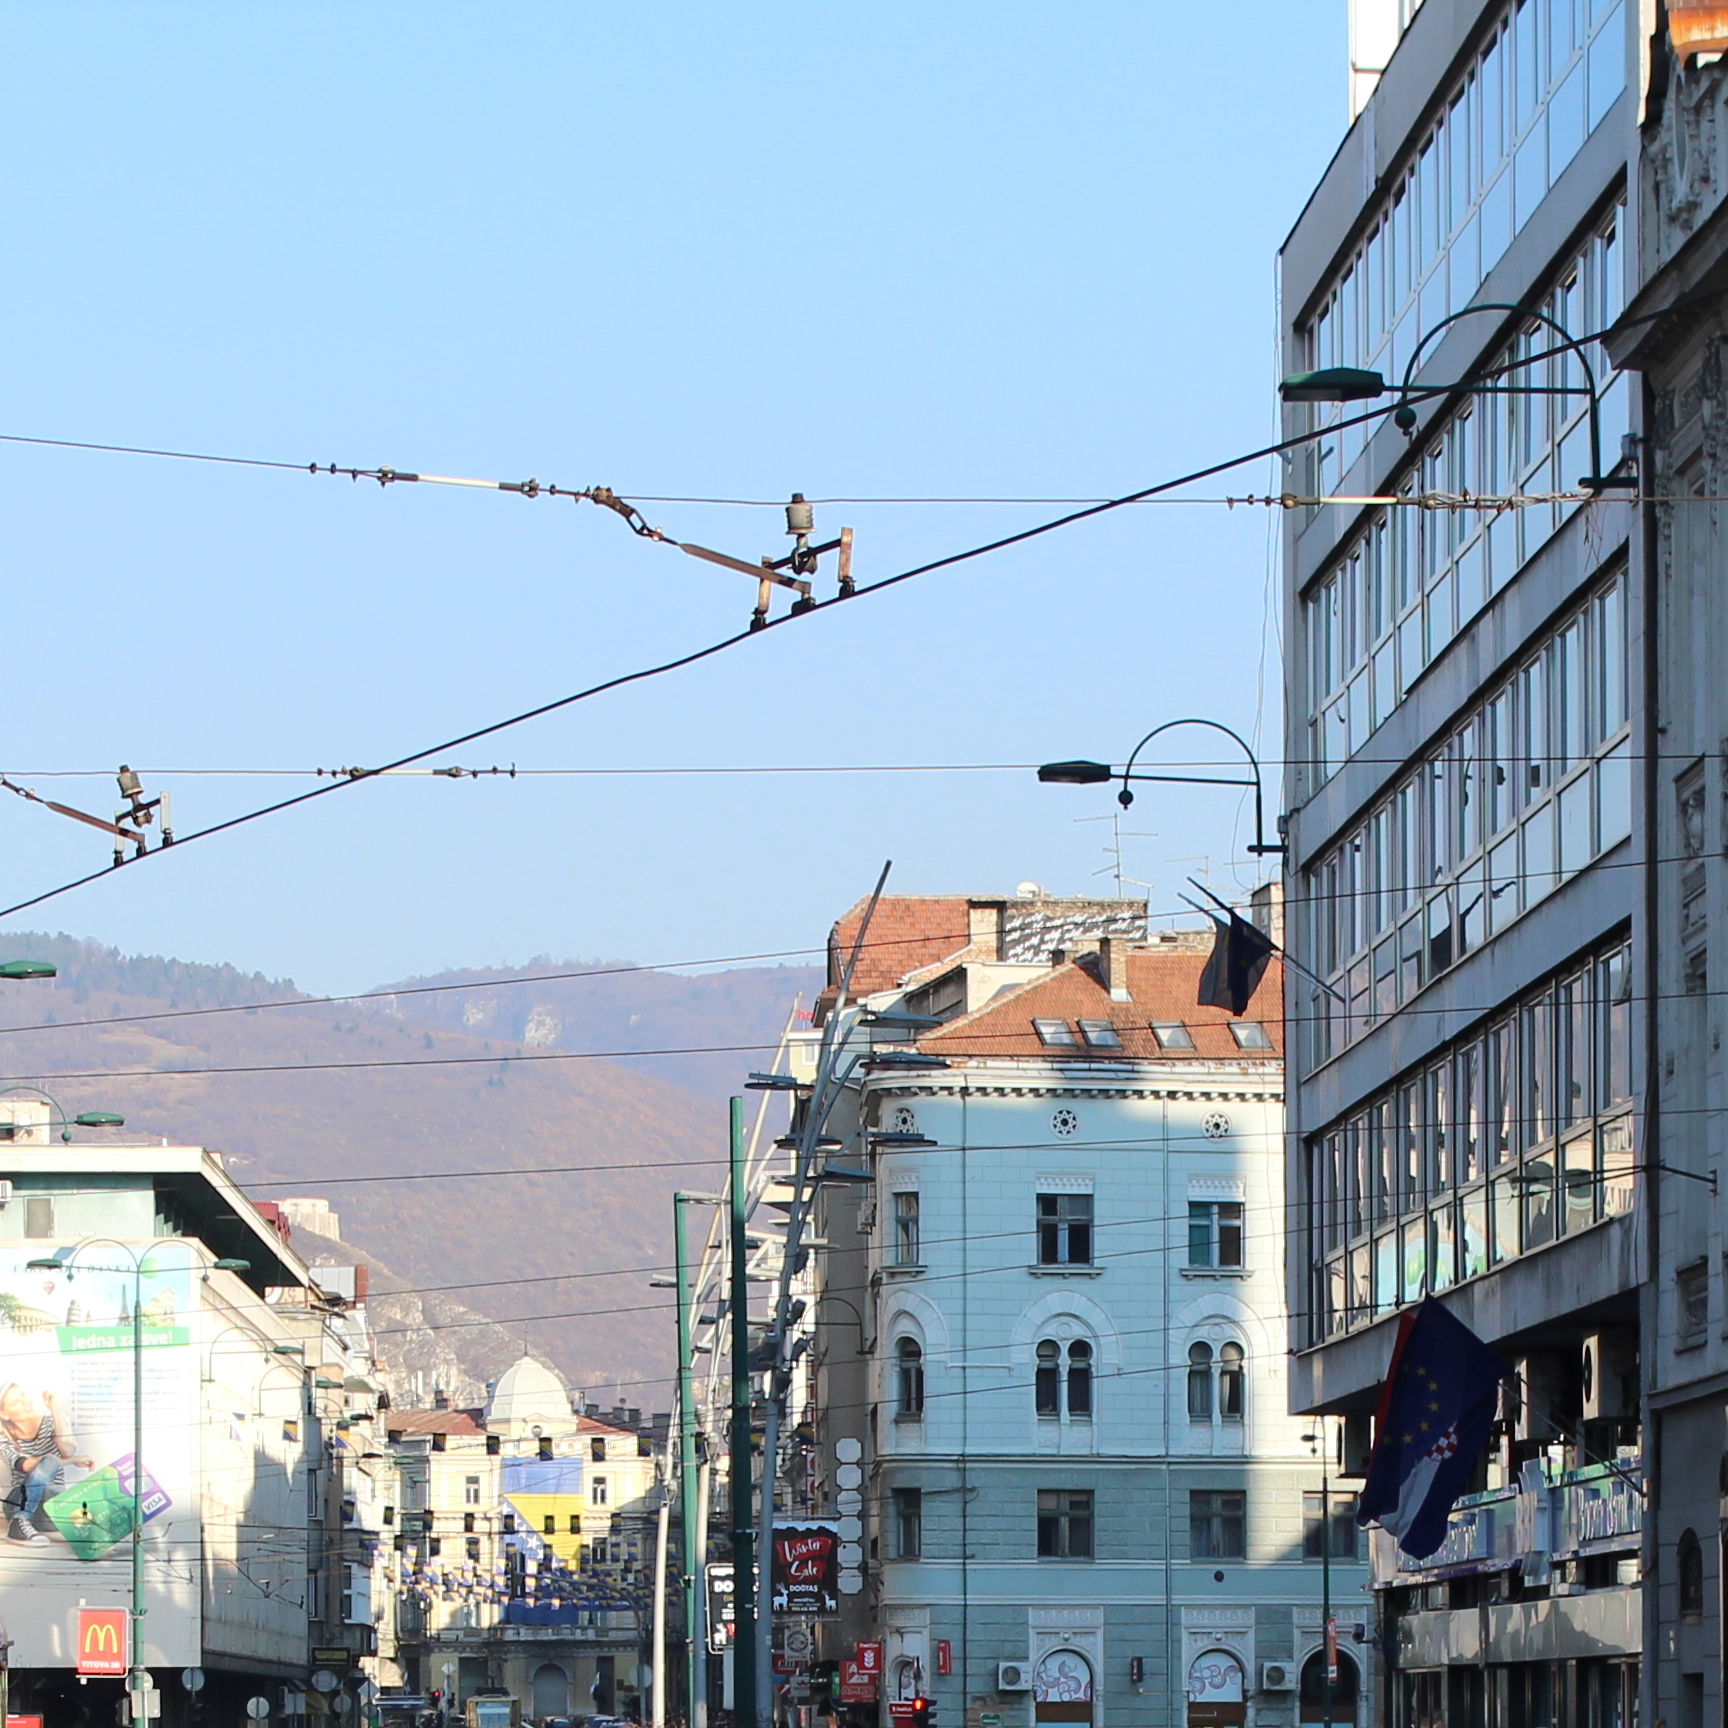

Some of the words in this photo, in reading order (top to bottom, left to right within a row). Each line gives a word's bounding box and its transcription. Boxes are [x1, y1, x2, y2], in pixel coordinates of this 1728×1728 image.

[72, 1333, 116, 1350] Jedna
[142, 1494, 164, 1511] VISA
[784, 1538, 822, 1562] Winter
[790, 1560, 818, 1581] Sale
